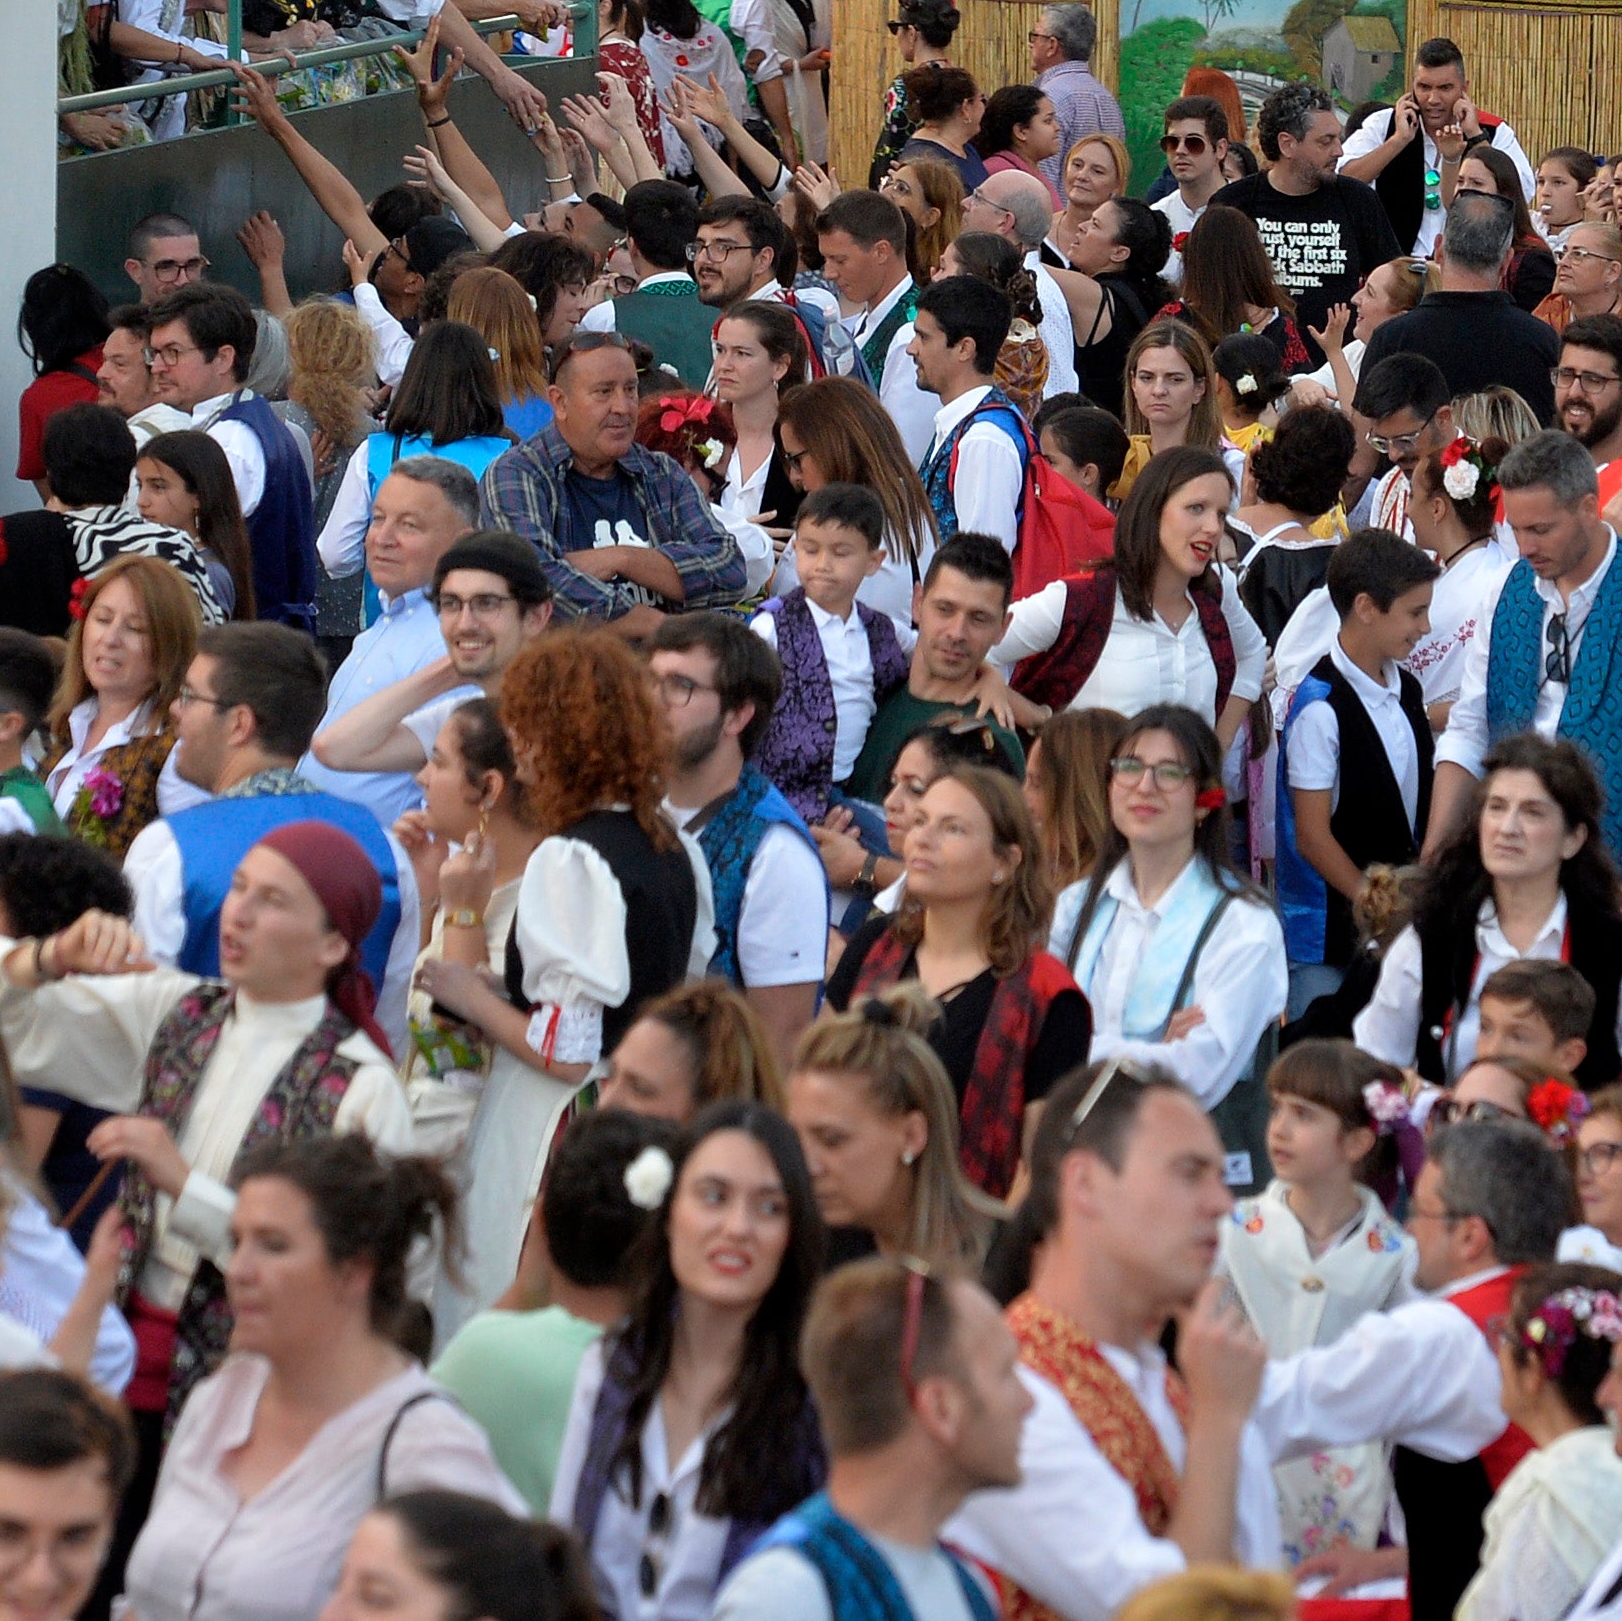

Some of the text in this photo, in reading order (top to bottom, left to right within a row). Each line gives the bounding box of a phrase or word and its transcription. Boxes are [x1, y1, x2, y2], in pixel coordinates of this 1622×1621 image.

[1256, 218, 1340, 234] You can only
[1287, 233, 1341, 248] yourself
[1278, 244, 1301, 259] the
[1303, 246, 1328, 260] first
[1330, 246, 1348, 260] six
[1289, 258, 1345, 274] Sabbath
